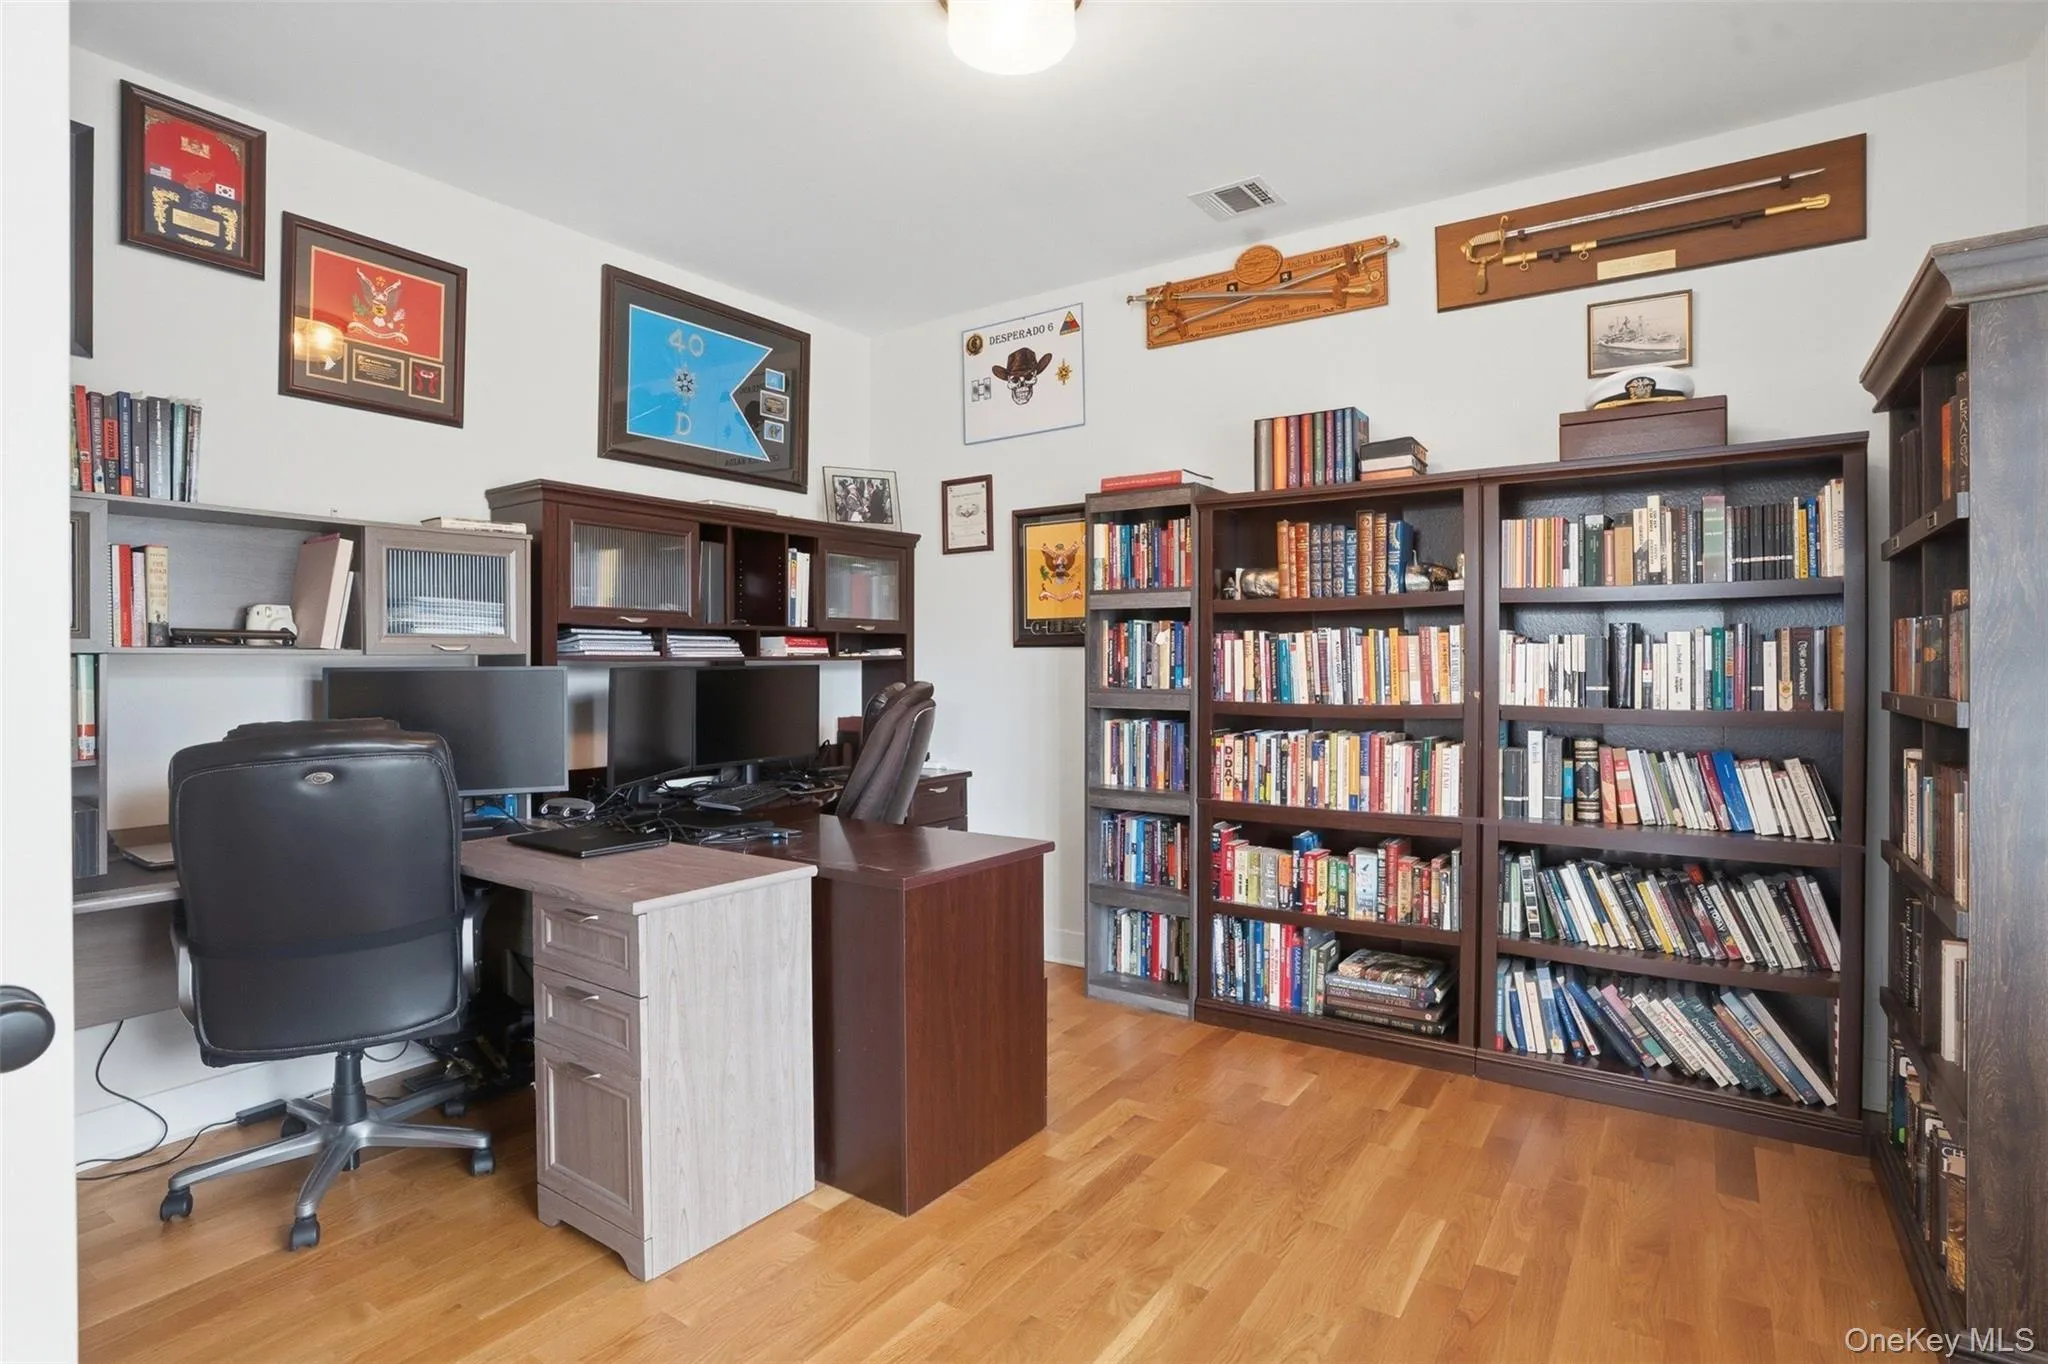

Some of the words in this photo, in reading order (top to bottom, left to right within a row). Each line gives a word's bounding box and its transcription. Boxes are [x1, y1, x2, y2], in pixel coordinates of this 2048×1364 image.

[667, 328, 705, 358] 40
[989, 325, 1045, 345] DESPERADO
[1047, 322, 1054, 332] 6
[675, 412, 692, 436] D
[1958, 398, 1969, 467] ERAGON
